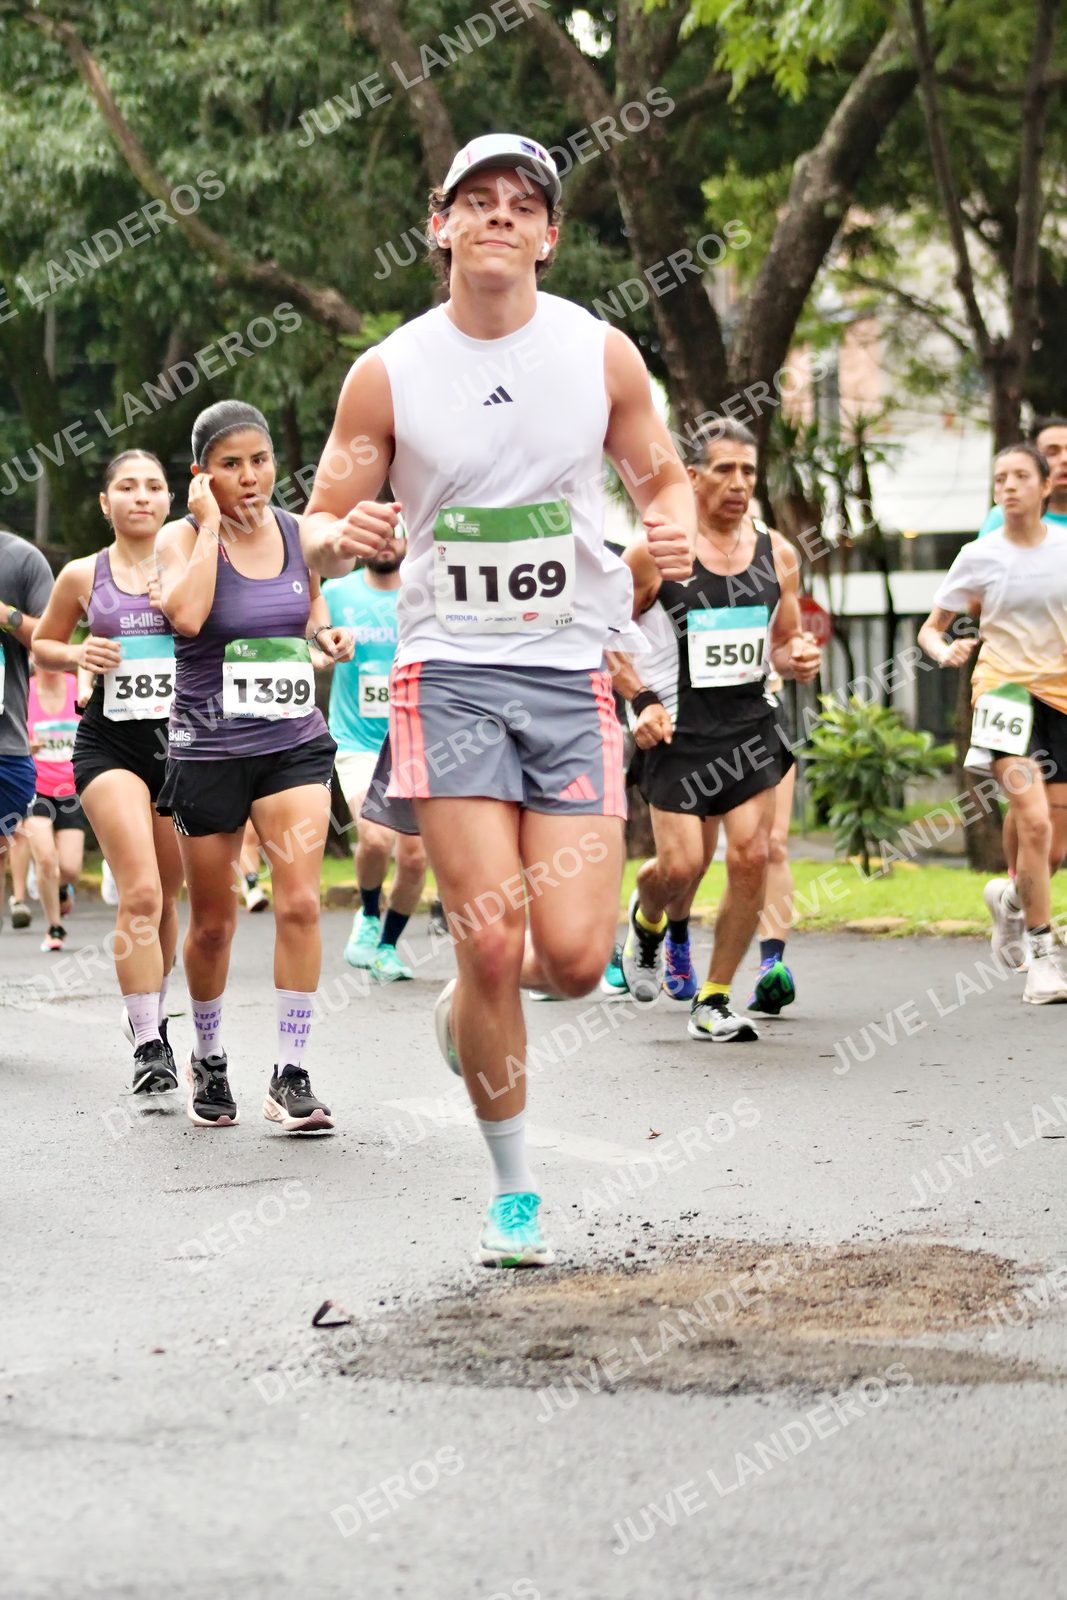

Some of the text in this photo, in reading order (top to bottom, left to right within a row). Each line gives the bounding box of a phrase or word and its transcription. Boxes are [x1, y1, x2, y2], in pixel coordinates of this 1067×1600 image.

[447, 561, 567, 602] 1169
[120, 612, 165, 629] skills
[115, 674, 173, 699] 383
[233, 678, 310, 705] 1399
[194, 1010, 221, 1020] JUS
[287, 1009, 313, 1018] JUS
[294, 1039, 306, 1047] IT
